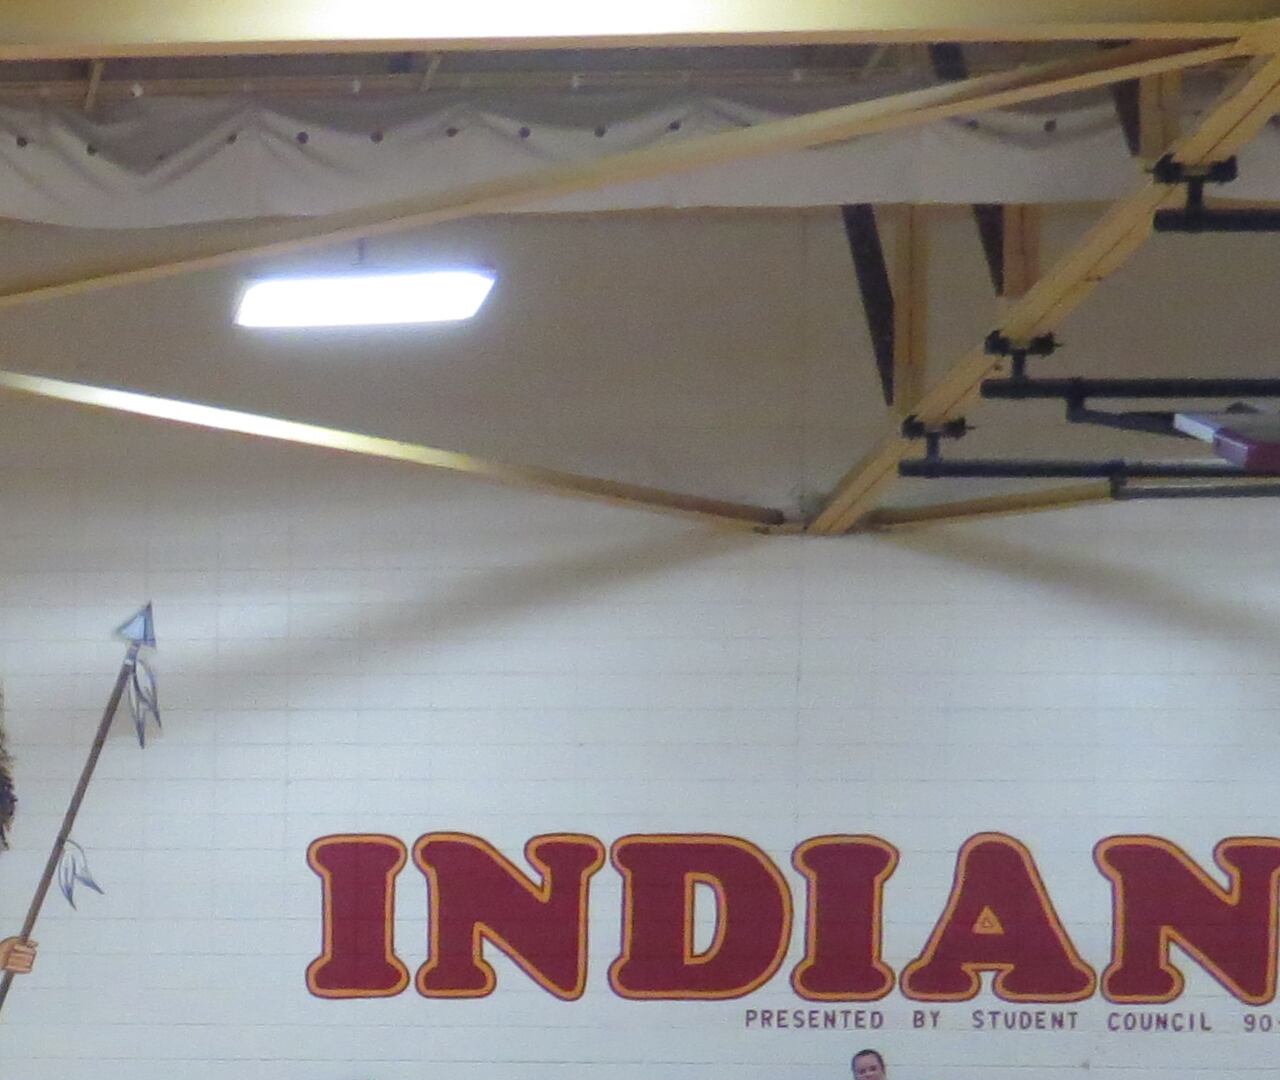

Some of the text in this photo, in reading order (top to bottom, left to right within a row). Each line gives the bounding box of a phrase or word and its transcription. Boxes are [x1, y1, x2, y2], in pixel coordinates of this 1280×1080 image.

[744, 1009, 885, 1030] PRESENTED
[911, 1009, 941, 1029] BY
[971, 1010, 1079, 1031] STUDENT
[1106, 1011, 1214, 1032] COUNCIL
